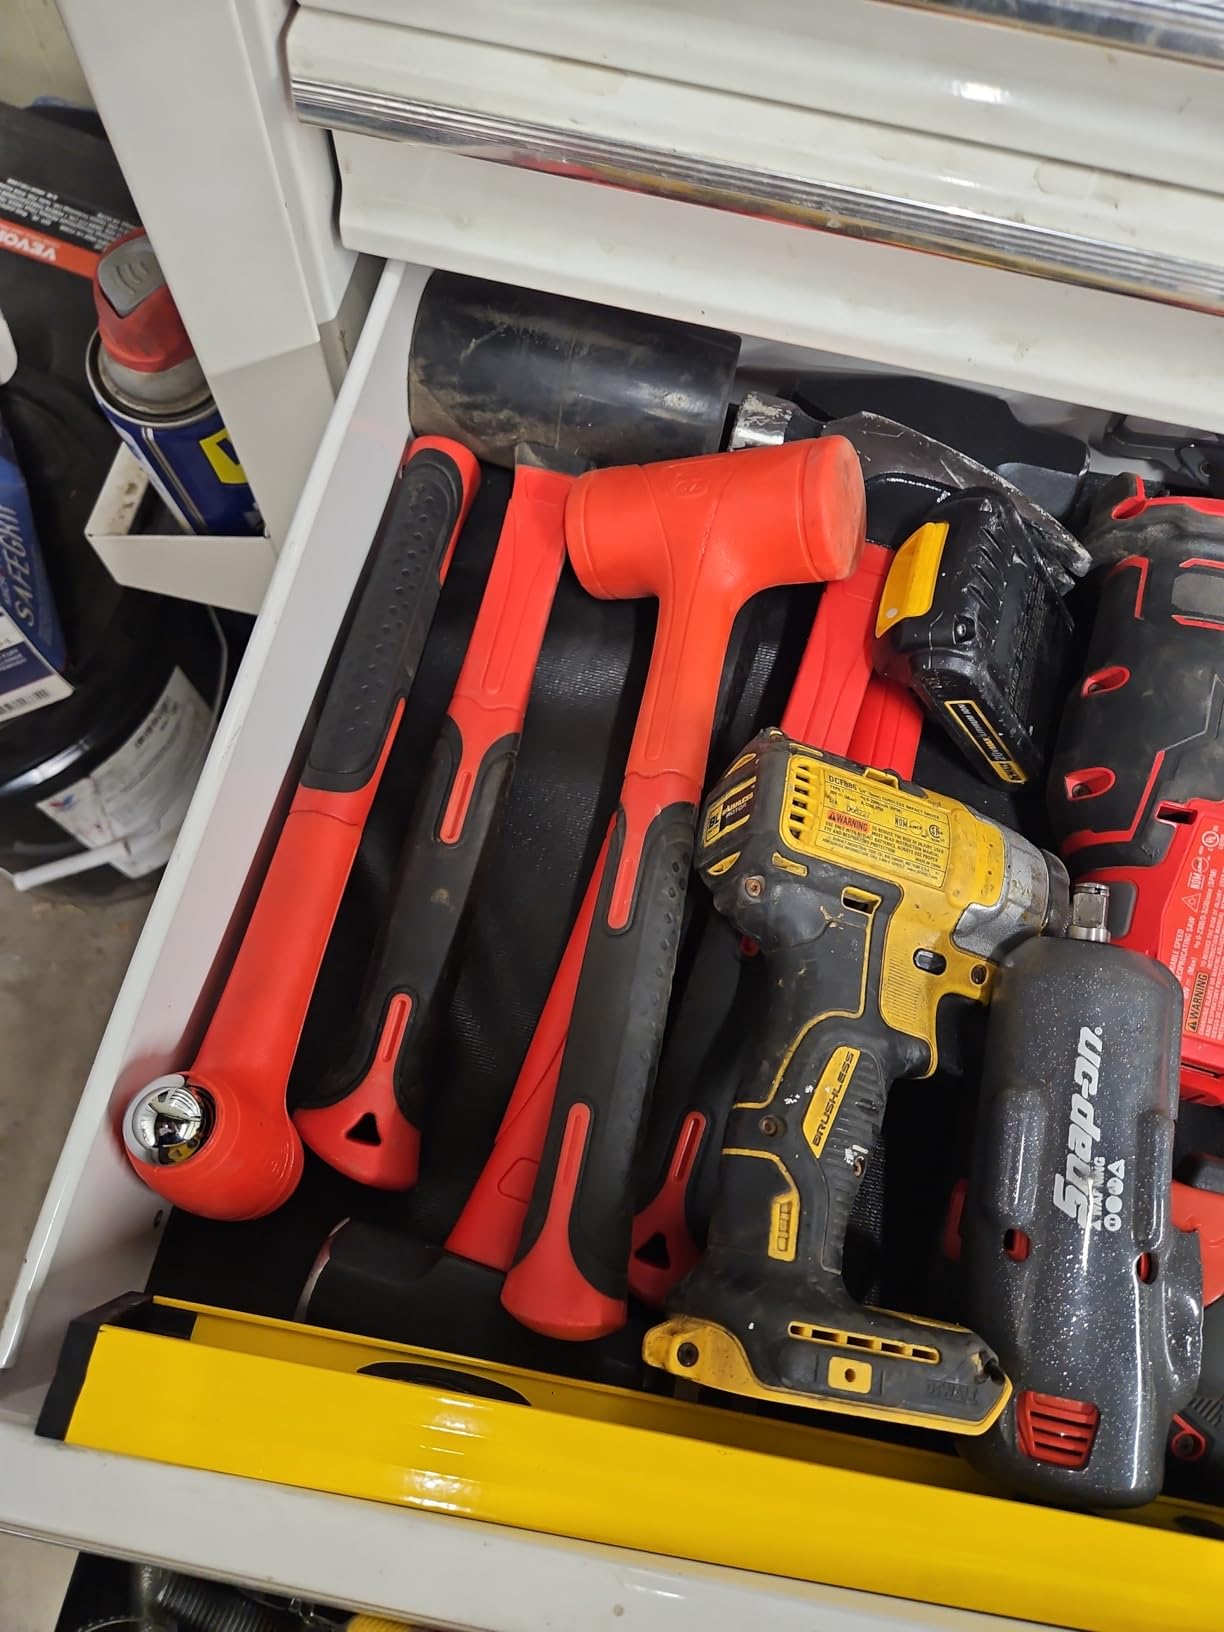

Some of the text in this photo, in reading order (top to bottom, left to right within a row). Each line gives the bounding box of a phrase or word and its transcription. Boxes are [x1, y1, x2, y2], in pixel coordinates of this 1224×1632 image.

[828, 775, 856, 789] DCF886
[836, 814, 867, 831] WARNING
[1174, 928, 1184, 948] SPEED
[1174, 932, 1192, 981] ECIPROCATING
[1189, 973, 1207, 1019] WARNING
[812, 1051, 854, 1147] BRUSHLESS
[1053, 1026, 1102, 1230] Snap-on
